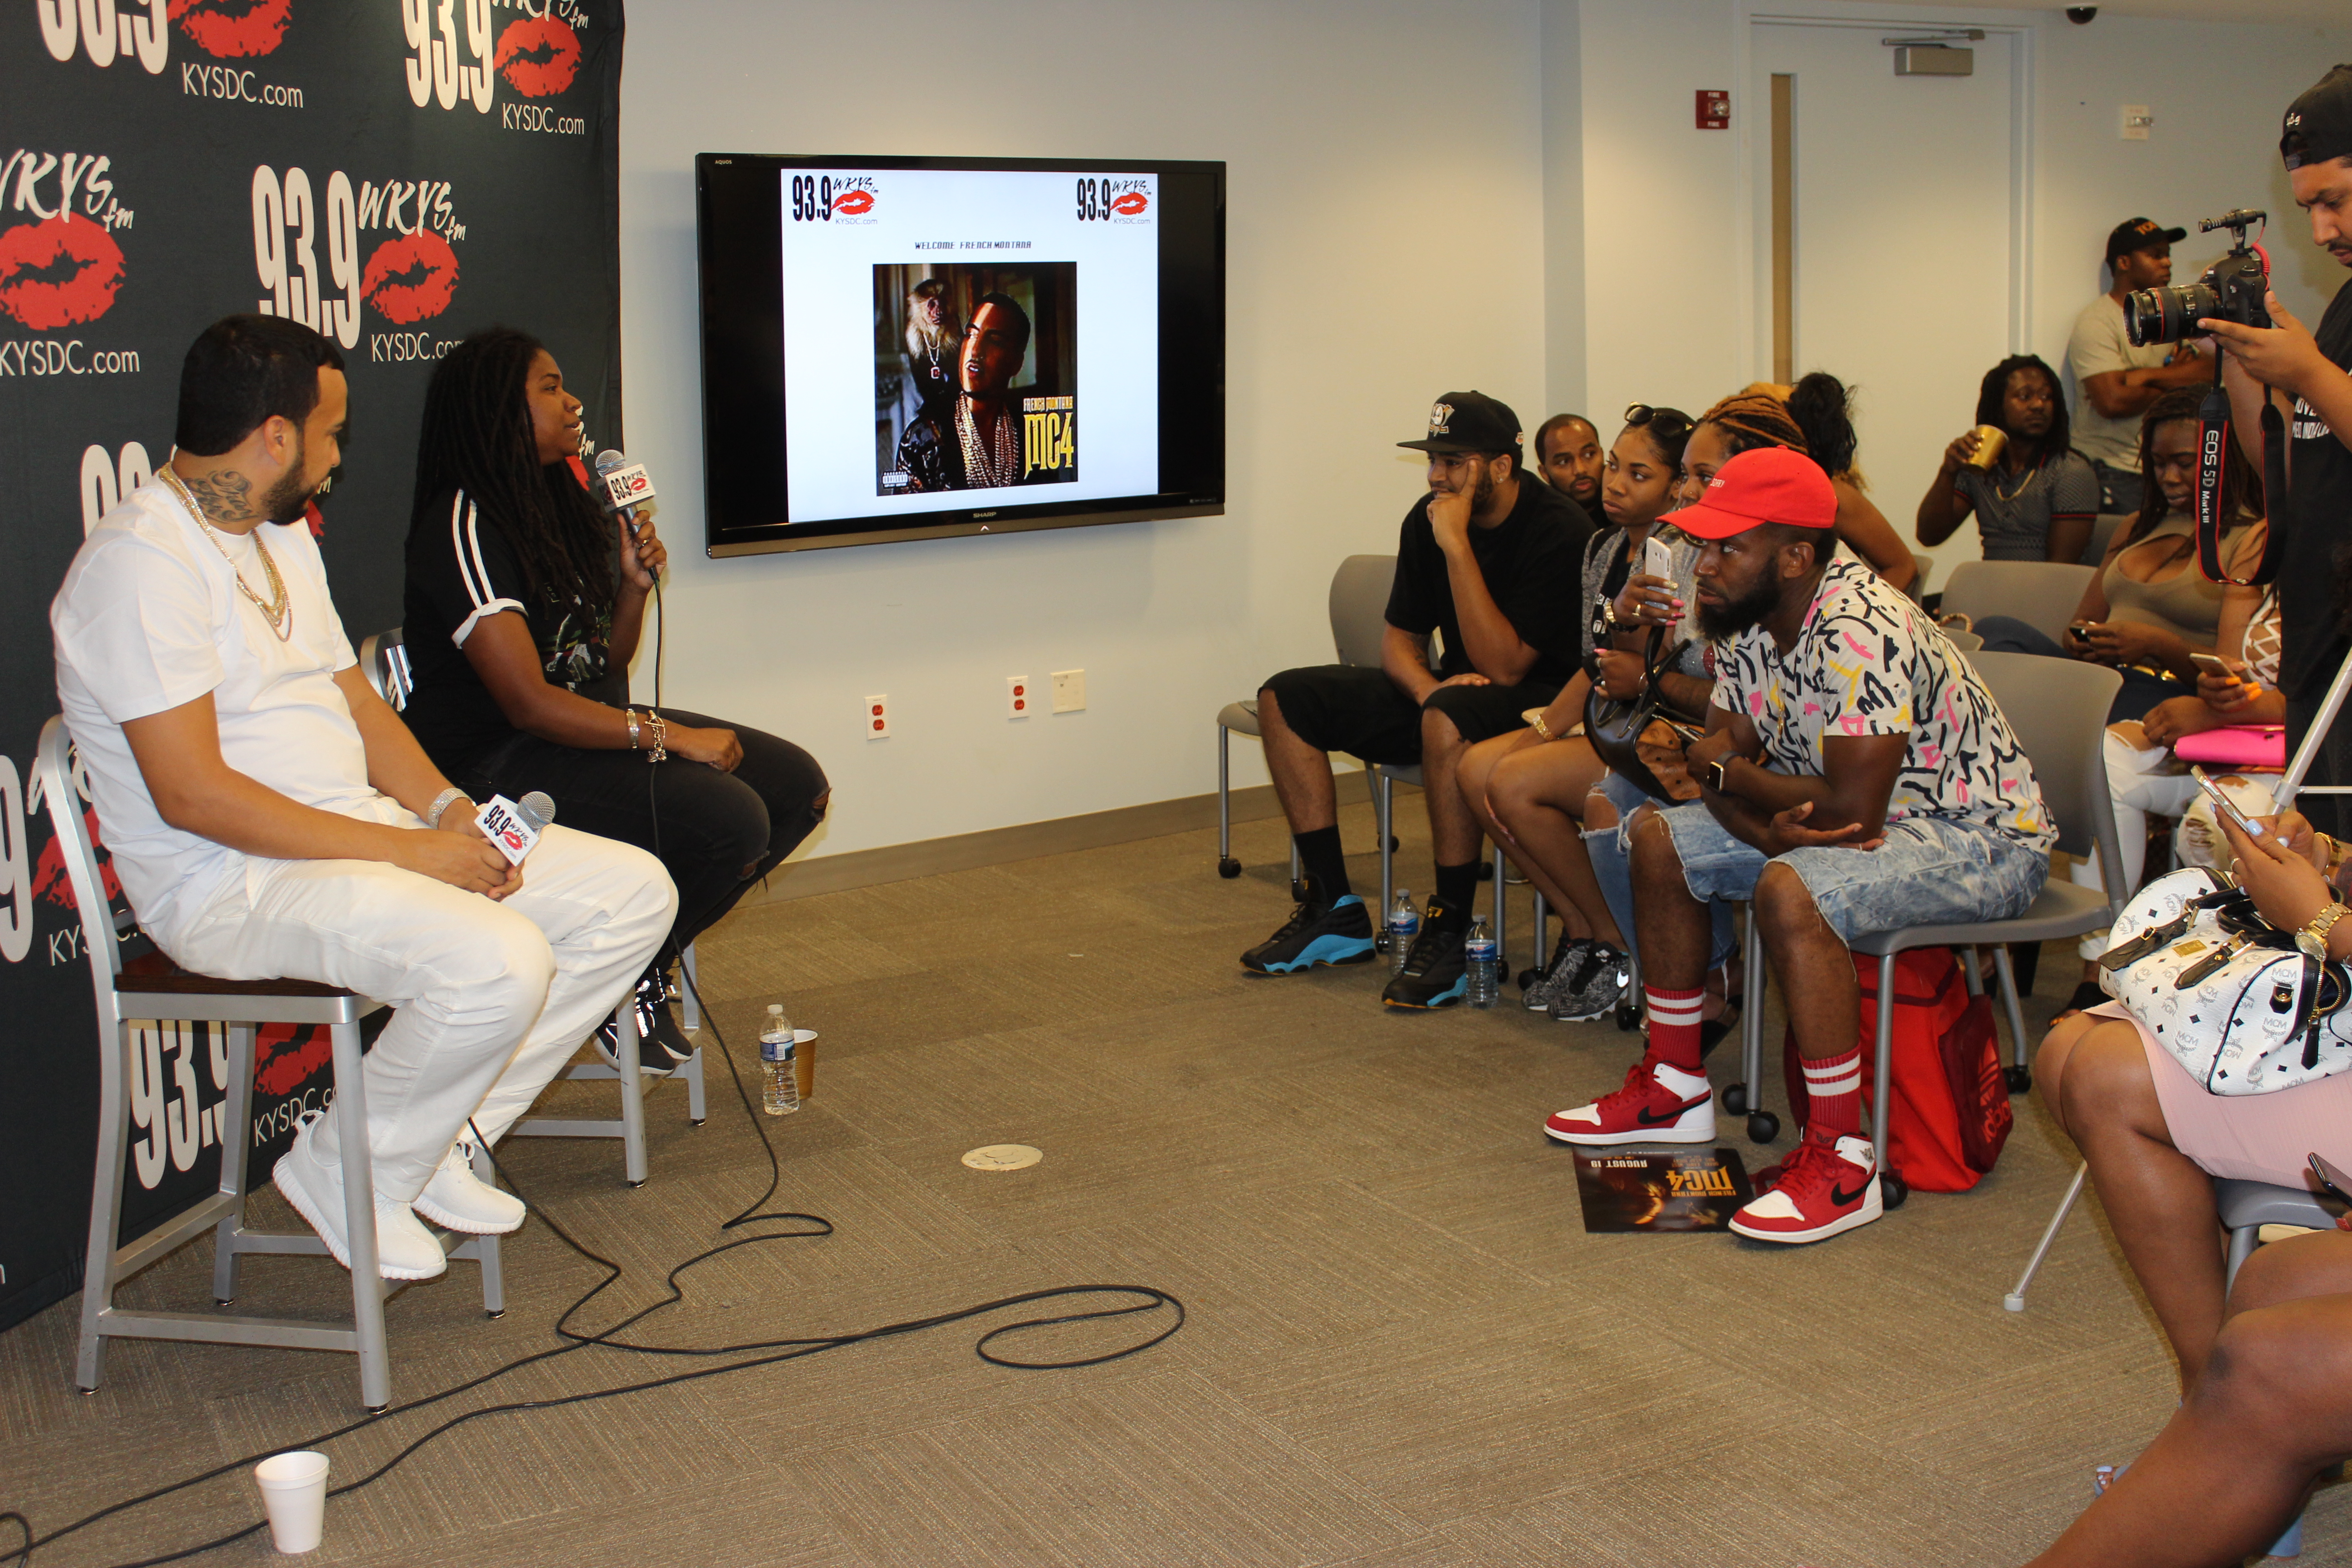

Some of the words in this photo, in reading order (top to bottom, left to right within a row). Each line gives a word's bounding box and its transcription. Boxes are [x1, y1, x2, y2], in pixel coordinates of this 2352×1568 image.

[182, 62, 304, 108] KYSDC.com
[503, 103, 585, 135] KYSDC.com
[793, 175, 832, 221] 93.9
[833, 177, 873, 191] WKYS
[1077, 178, 1111, 220] 93.9
[1112, 180, 1147, 193] WKYS
[252, 164, 361, 349] 93.9
[358, 179, 453, 238] WKYS
[1024, 412, 1074, 480] MC4
[2205, 430, 2220, 466] EOS
[610, 476, 632, 500] 93.9
[2203, 470, 2216, 487] 5D
[2202, 490, 2210, 514] Mark
[483, 805, 512, 836] 93.9
[2272, 968, 2297, 979] MCM
[2264, 1017, 2287, 1029] MCM
[2176, 1031, 2200, 1046] MCM
[1590, 1160, 1602, 1168] 19
[1606, 1160, 1648, 1168] AUGUST
[1666, 1166, 1735, 1191] MC4
